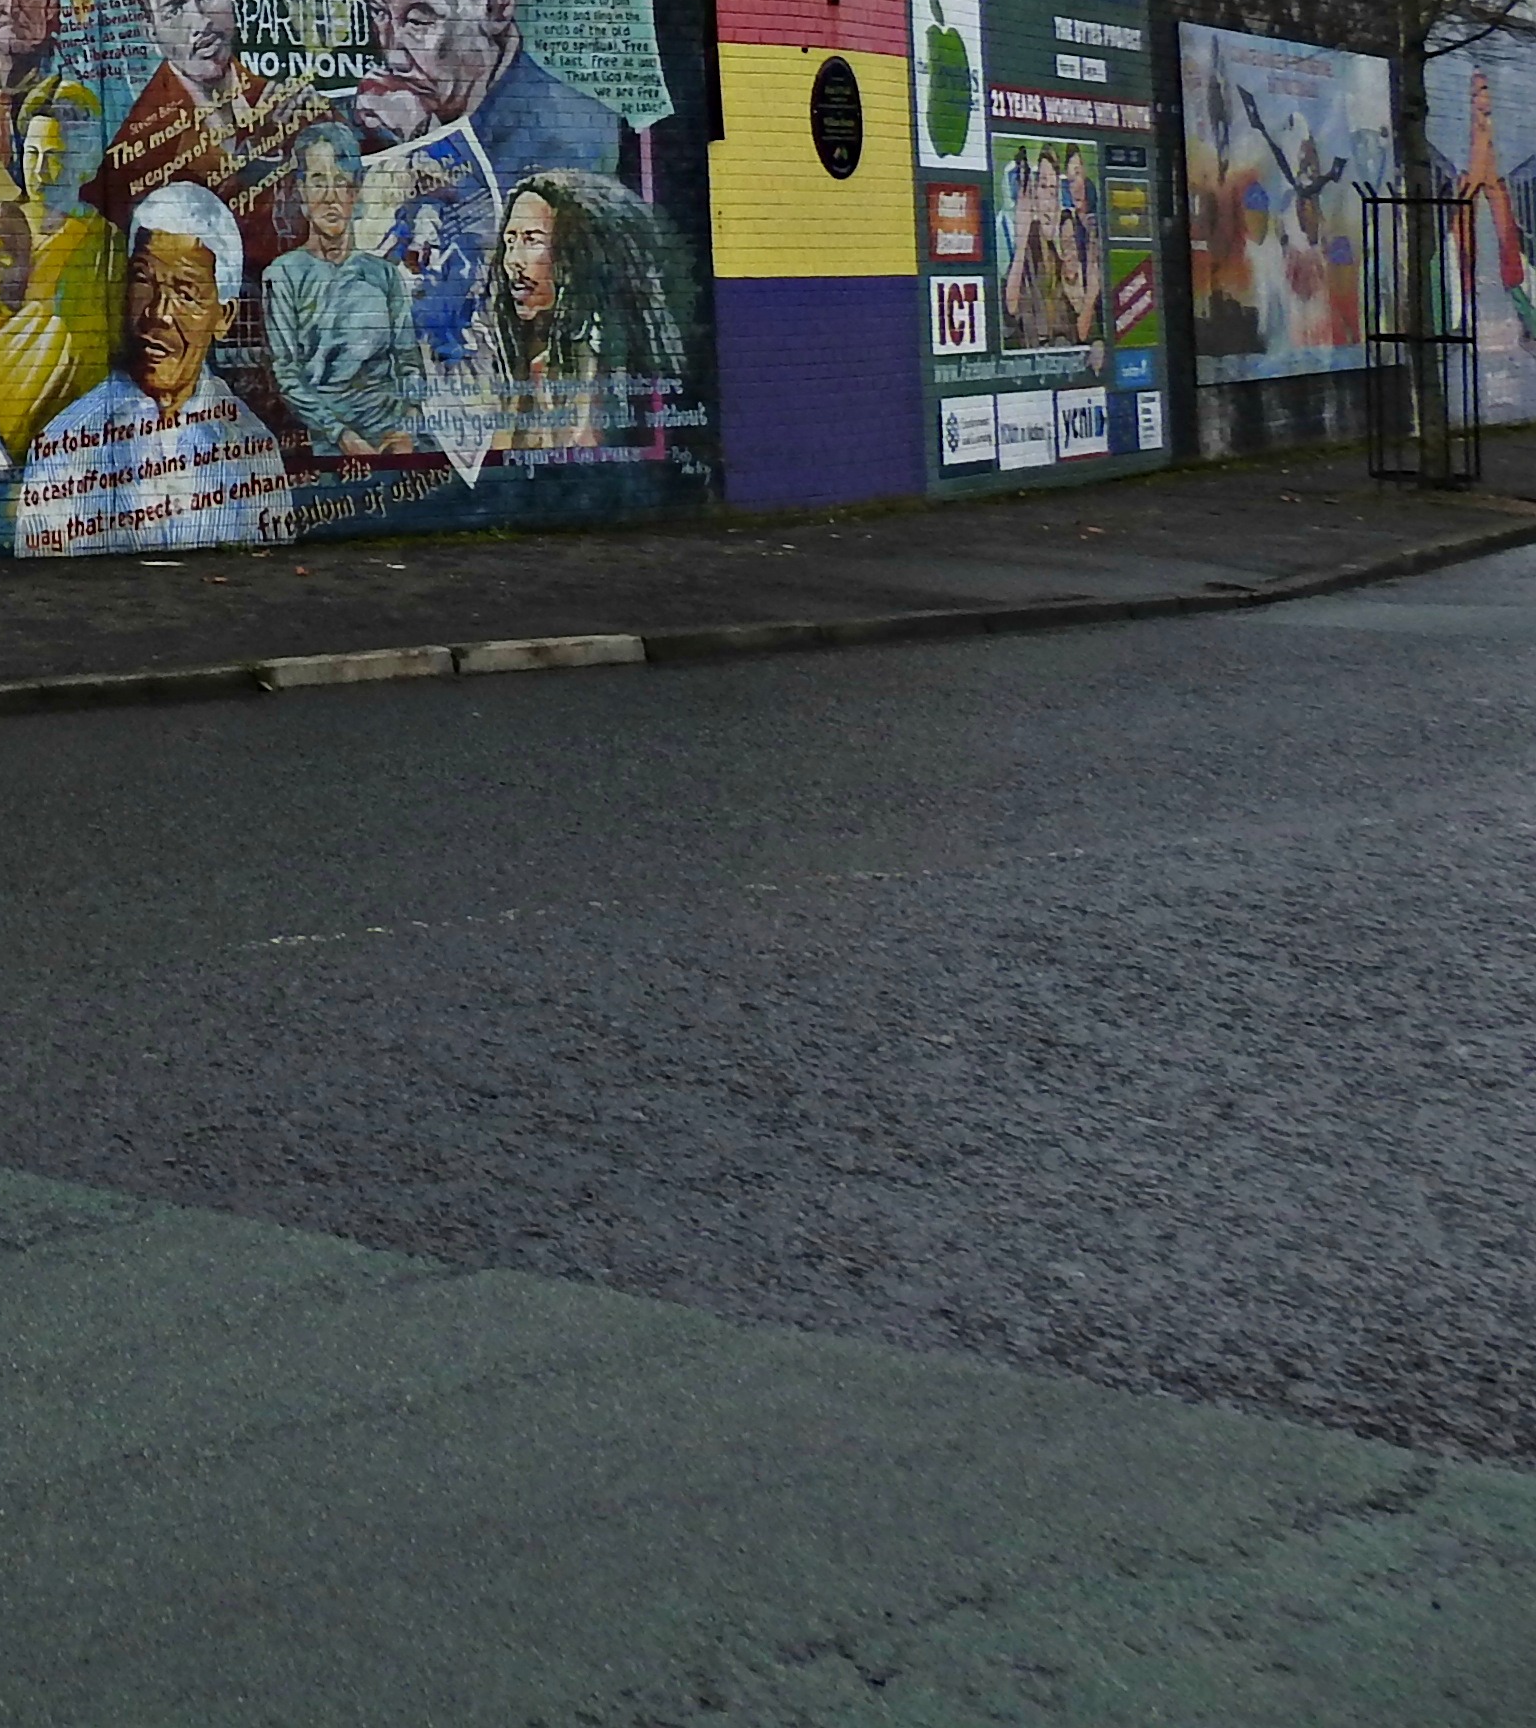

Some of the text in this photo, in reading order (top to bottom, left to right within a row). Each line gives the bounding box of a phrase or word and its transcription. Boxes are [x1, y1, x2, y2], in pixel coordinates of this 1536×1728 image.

[106, 141, 146, 170] The
[149, 109, 192, 150] most
[129, 153, 194, 196] weapon
[192, 130, 212, 158] of
[209, 122, 236, 147] the
[206, 170, 222, 188] is
[220, 153, 247, 179] the
[248, 120, 284, 162] mind
[937, 282, 979, 347] ICT
[63, 398, 238, 454] to be free is not merely
[23, 483, 39, 507] to
[43, 477, 76, 502] cast
[76, 468, 99, 494] off
[138, 453, 187, 480] chains
[193, 442, 220, 467] but
[223, 441, 242, 461] to
[244, 434, 274, 457] live
[25, 527, 63, 553] way
[67, 508, 104, 542] that
[190, 481, 225, 512] and
